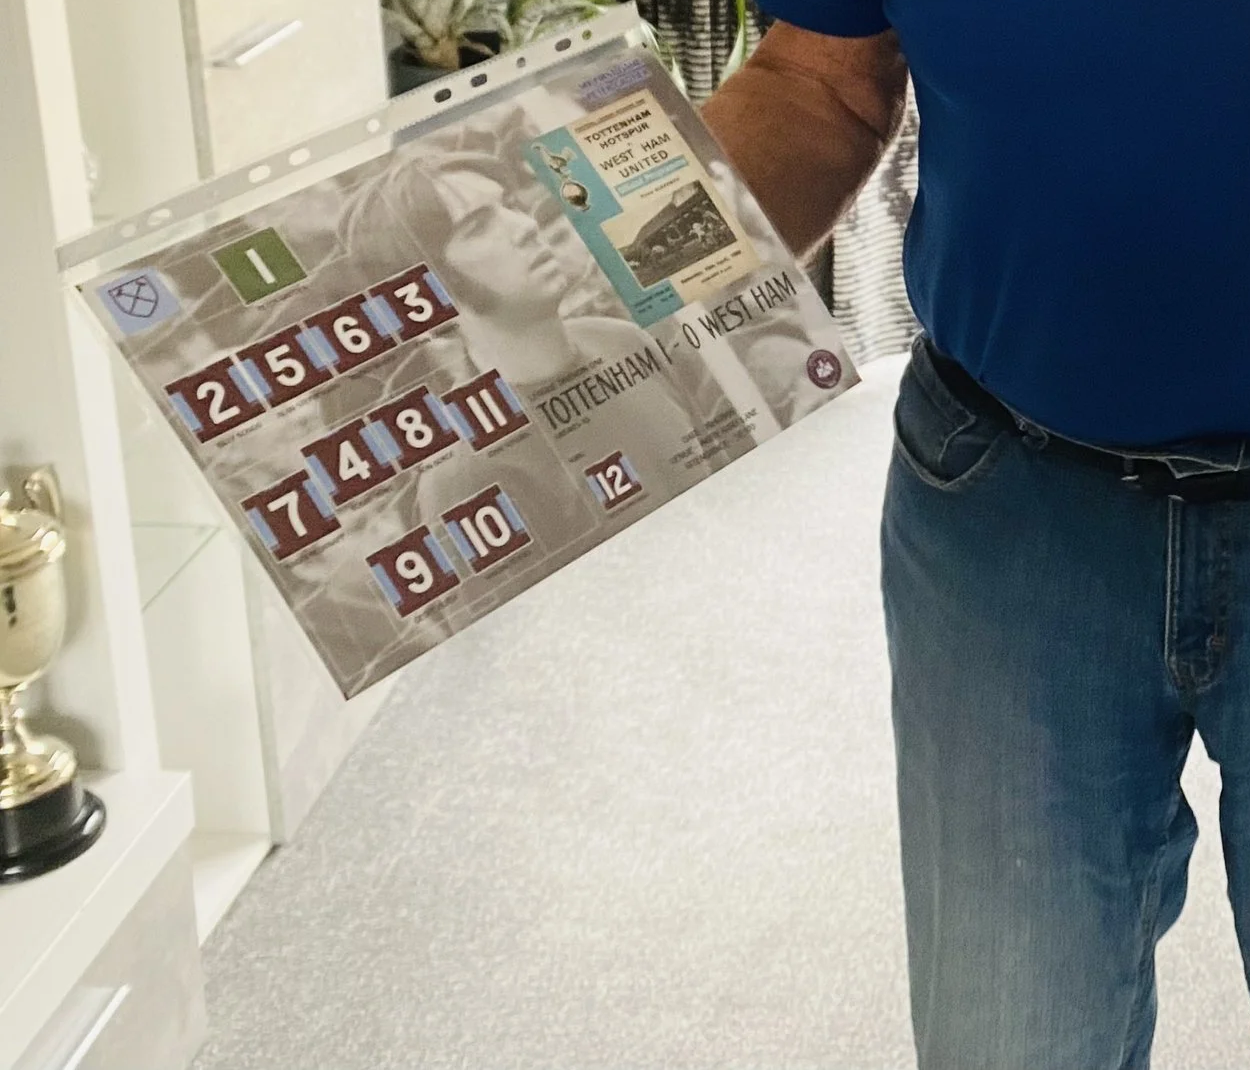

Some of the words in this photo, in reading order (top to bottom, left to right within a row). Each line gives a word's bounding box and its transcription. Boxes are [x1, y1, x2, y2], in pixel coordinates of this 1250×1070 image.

[584, 110, 652, 144] TOTTENHAM
[599, 122, 650, 149] HOTSPUR
[600, 148, 639, 171] WEST
[641, 133, 671, 151] HAM
[619, 150, 669, 178] UNITED
[245, 249, 276, 284] 1
[196, 381, 240, 425] 2
[264, 344, 305, 386] 5
[332, 316, 371, 353] 6
[394, 282, 433, 322] 3
[536, 347, 662, 430] TOTTENHAM
[698, 303, 756, 340] WEST
[753, 271, 798, 316] HAM
[266, 490, 308, 537] 7
[338, 440, 371, 481] 4
[396, 408, 433, 448] 8
[466, 389, 507, 433] 11
[595, 464, 633, 501] 12
[395, 551, 434, 594] 9
[459, 505, 511, 558] 10
